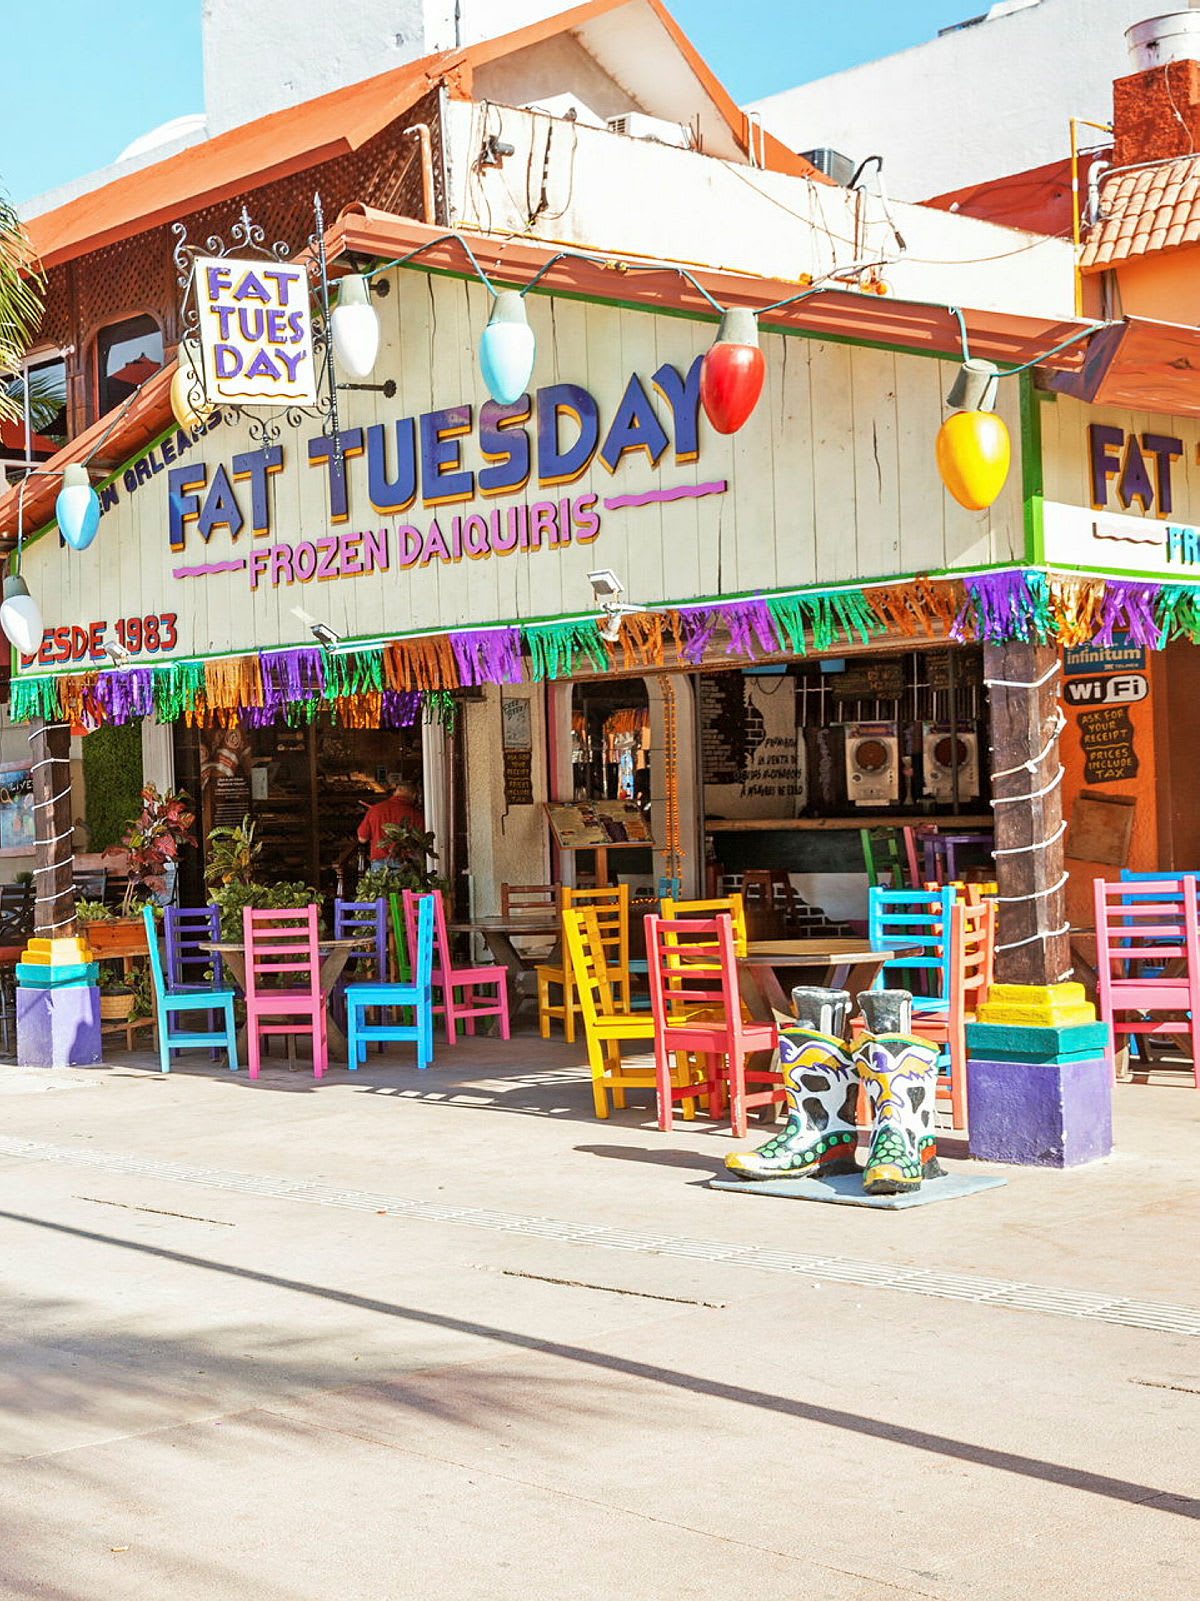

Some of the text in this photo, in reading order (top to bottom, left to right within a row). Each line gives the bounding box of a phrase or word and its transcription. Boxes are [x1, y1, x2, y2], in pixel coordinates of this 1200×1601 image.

[206, 266, 300, 306] FAT
[210, 305, 305, 345] TUES
[213, 343, 307, 383] DAY
[167, 444, 284, 553] FAT
[307, 354, 706, 527] TUESDAY
[1086, 423, 1184, 520] FAT
[249, 493, 601, 591] FROZEN DAIQUIRIS
[114, 612, 178, 656] 1983
[1067, 648, 1142, 665] infinitum
[1081, 709, 1123, 725] ASK FOR
[1088, 720, 1116, 733] YOUR
[1084, 728, 1128, 743] RECEIPT
[1087, 757, 1133, 771] INCLUDE
[1090, 748, 1129, 760] PRICES
[1095, 768, 1124, 779] TAX
